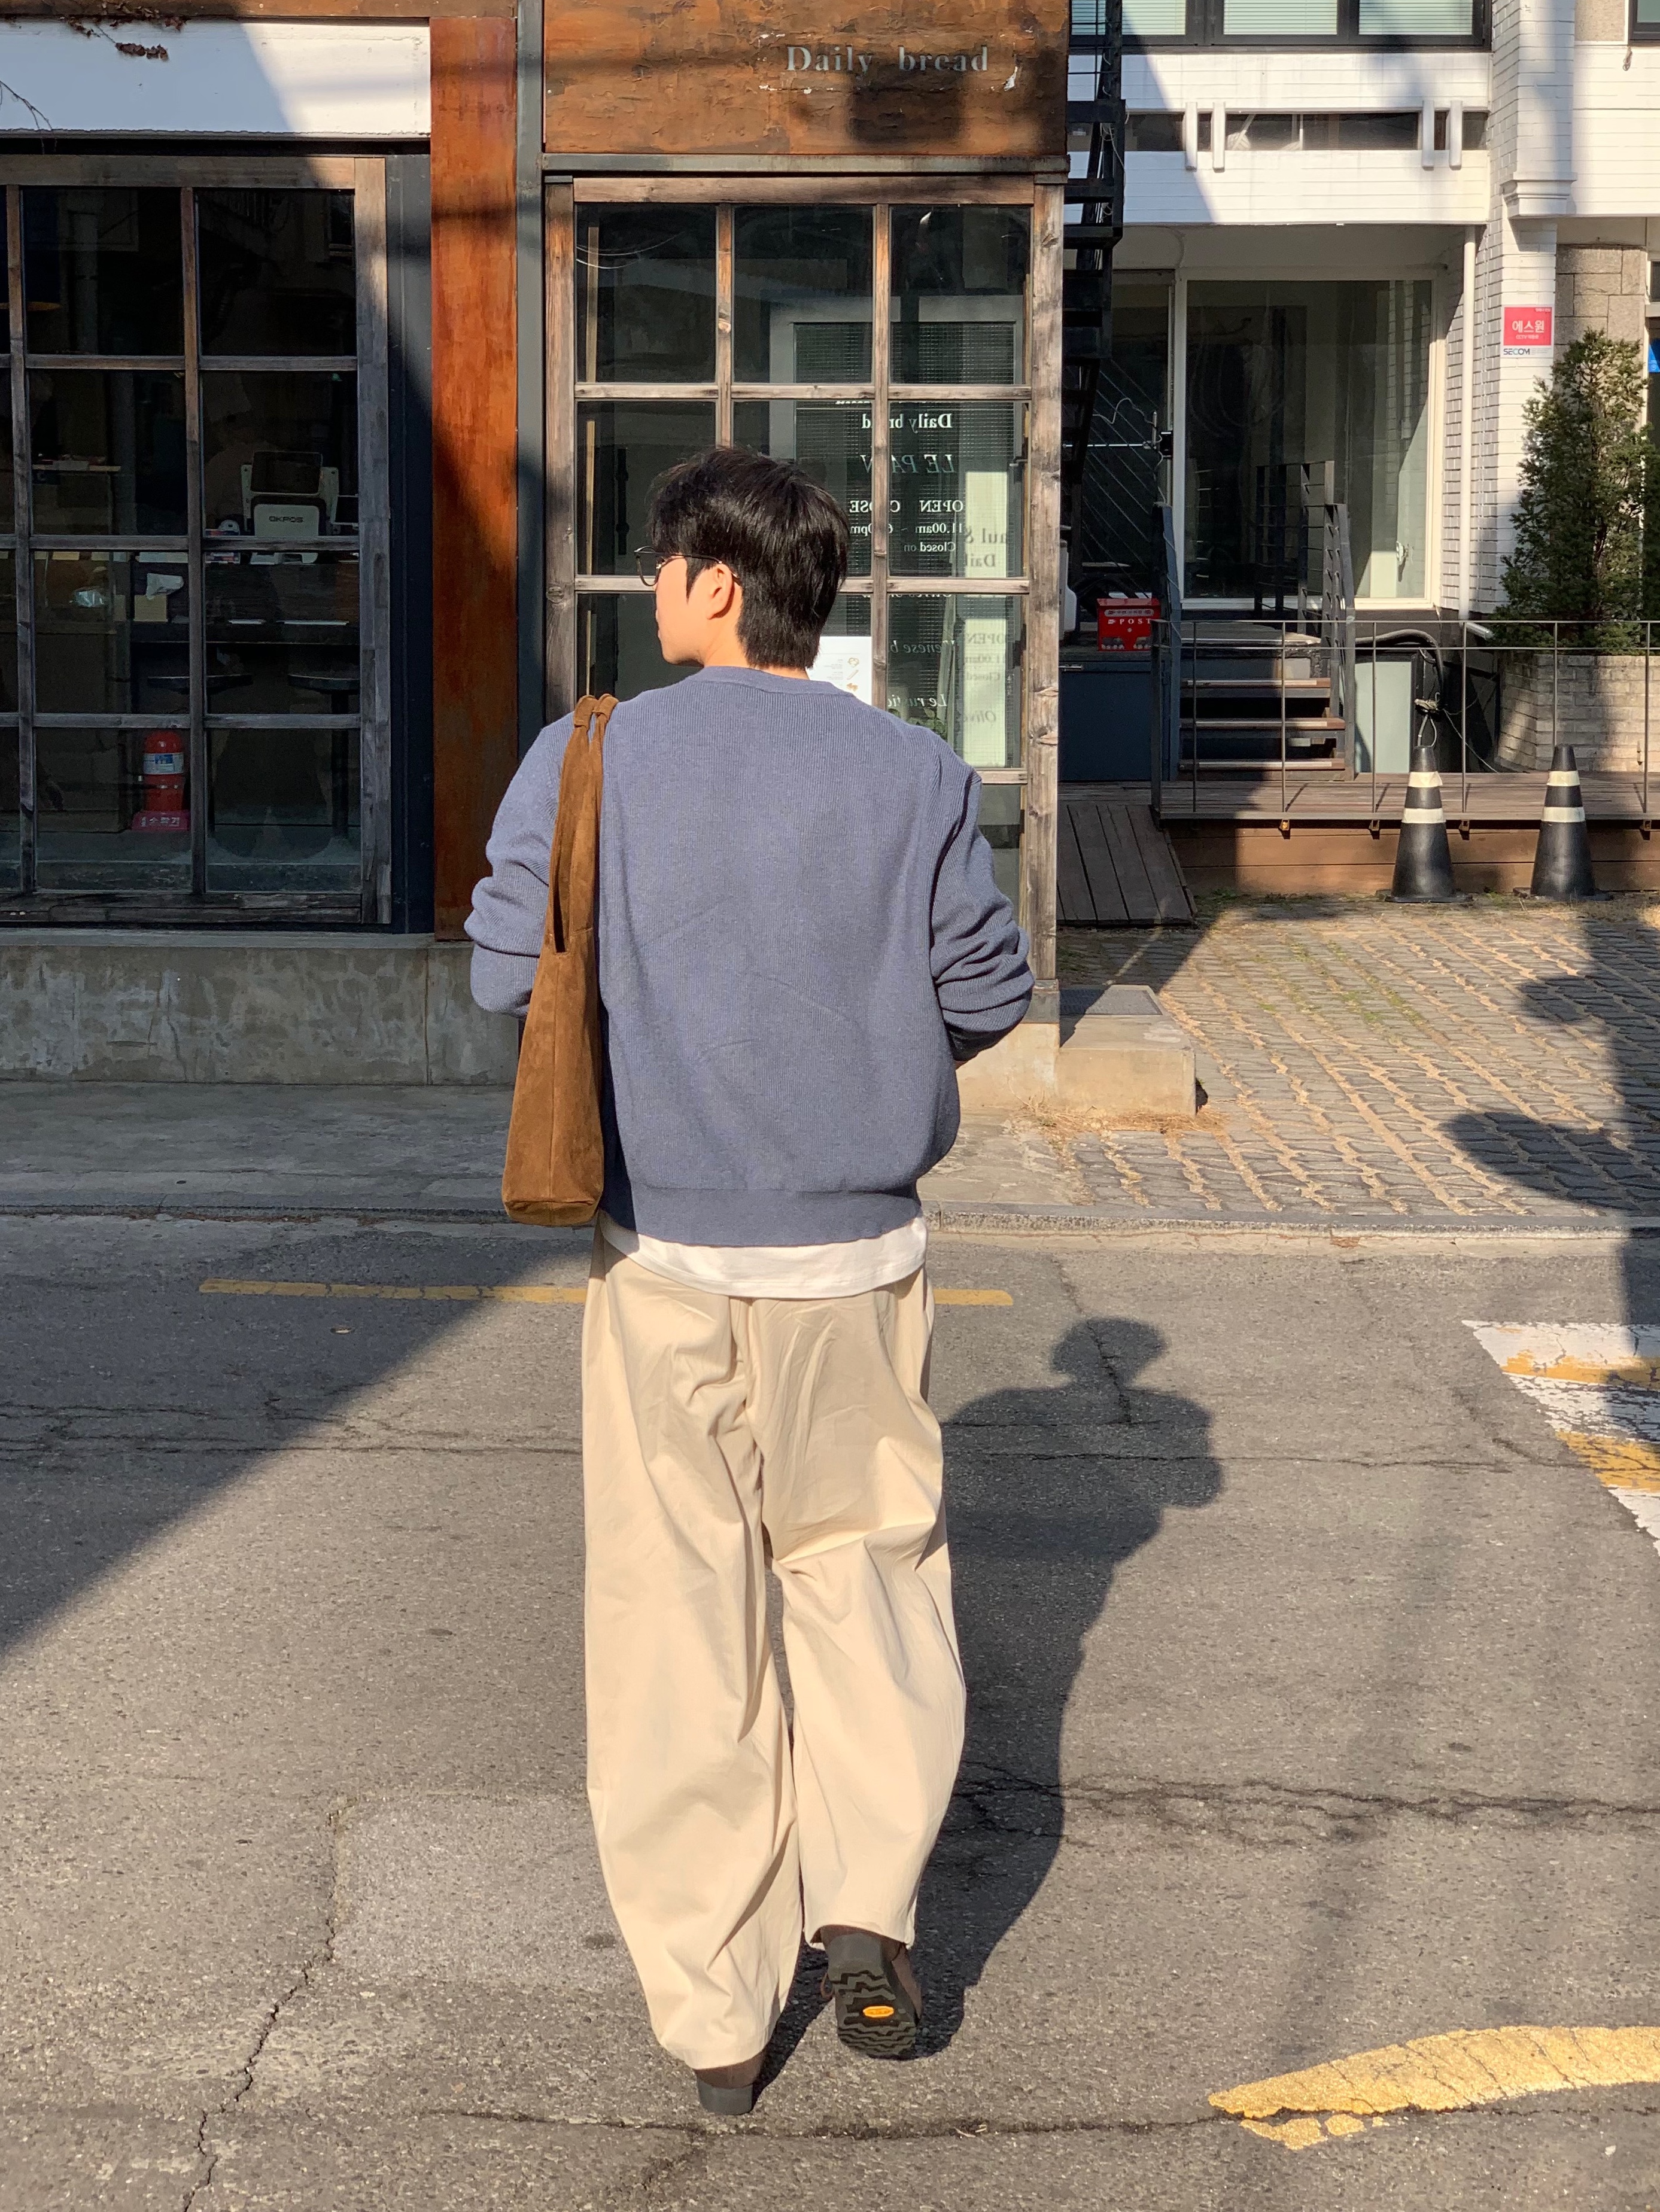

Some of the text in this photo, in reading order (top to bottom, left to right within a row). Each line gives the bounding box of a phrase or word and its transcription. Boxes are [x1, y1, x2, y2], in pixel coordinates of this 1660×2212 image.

[786, 45, 989, 74] Daily bread
[1512, 320, 1545, 333] 에스원
